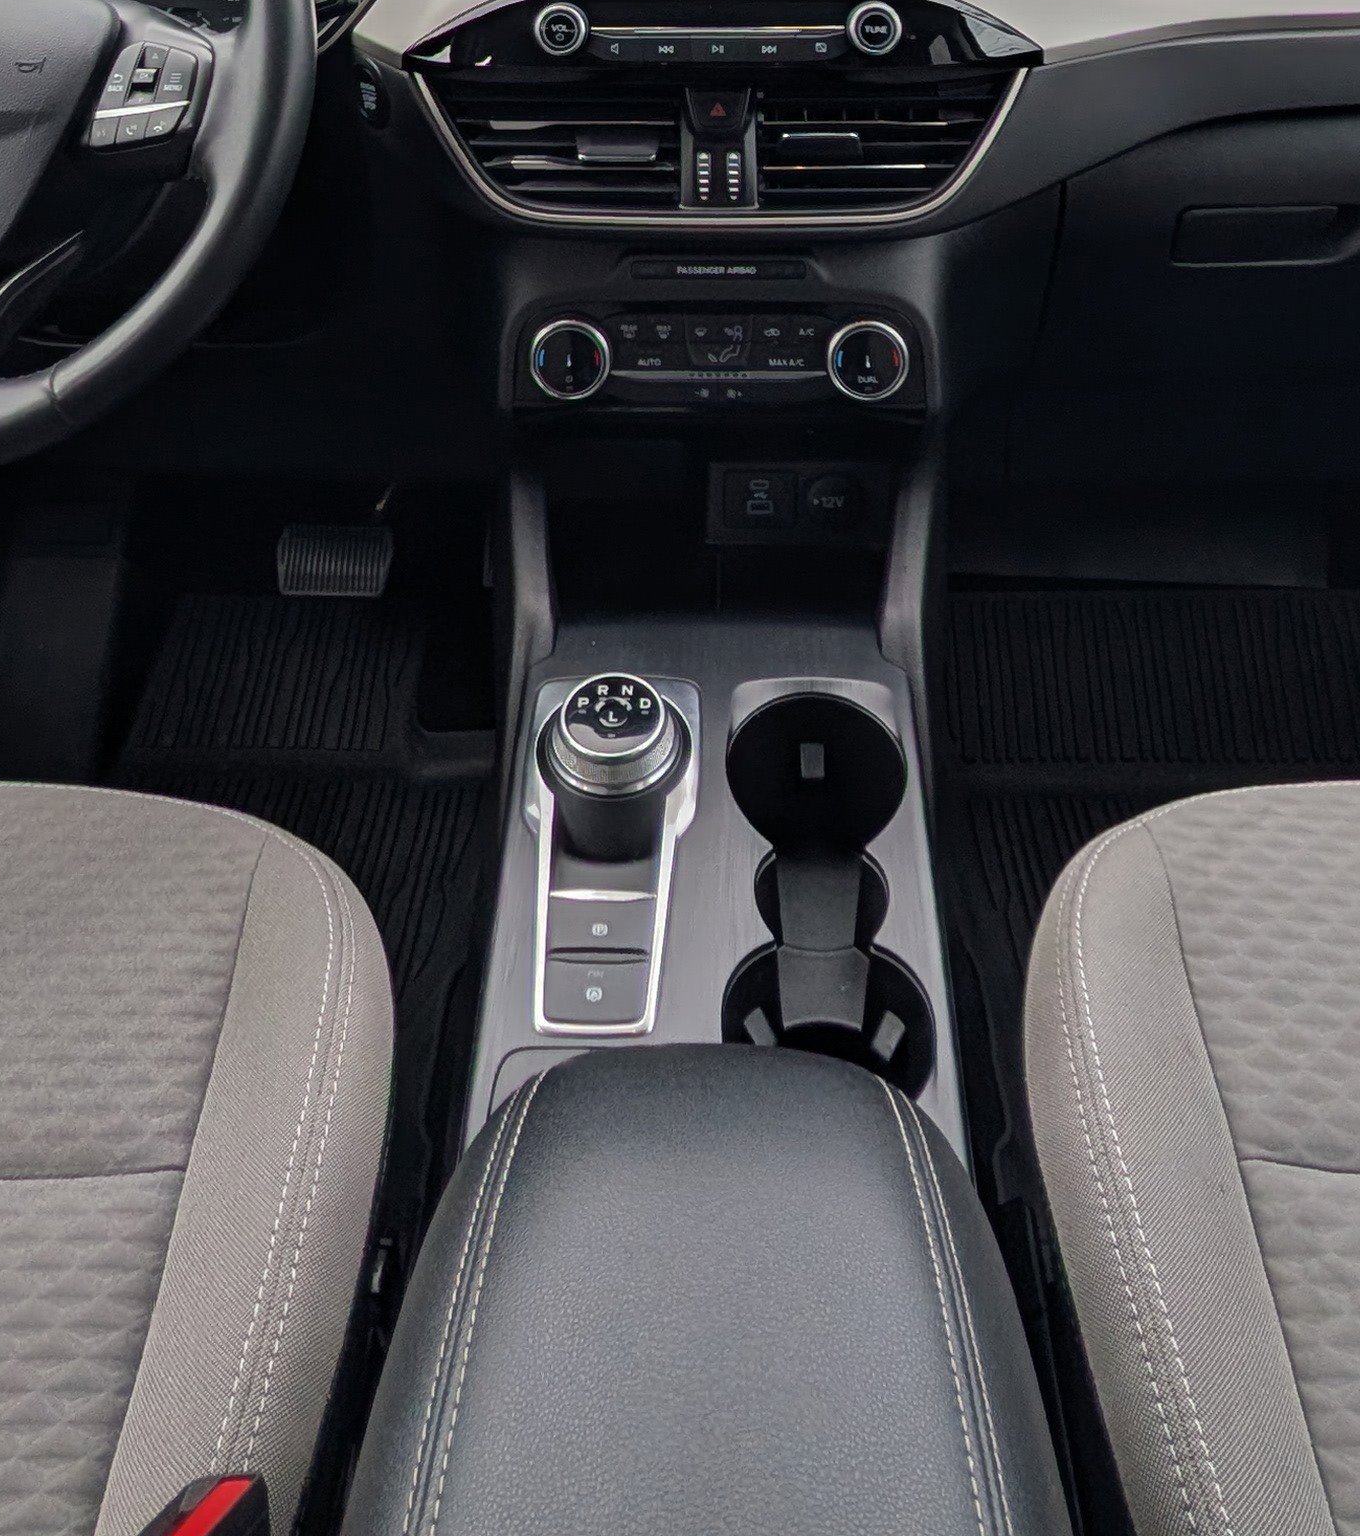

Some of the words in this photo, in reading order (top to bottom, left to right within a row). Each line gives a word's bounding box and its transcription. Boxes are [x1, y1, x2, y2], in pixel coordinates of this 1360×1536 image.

[551, 24, 569, 33] VOL
[864, 25, 886, 34] TUNE
[107, 84, 124, 92] BACK
[676, 265, 725, 275] PASSENGER
[727, 265, 757, 275] AIRBAG
[798, 327, 815, 337] A/C
[637, 357, 662, 367] AUTO
[769, 357, 787, 367] MAX
[788, 357, 806, 367] A/C
[857, 375, 878, 384] DUAL
[821, 496, 845, 509] 12V
[597, 685, 609, 695] R
[621, 685, 634, 695] N
[578, 698, 589, 709] P
[640, 699, 652, 709] D
[608, 711, 618, 722] L
